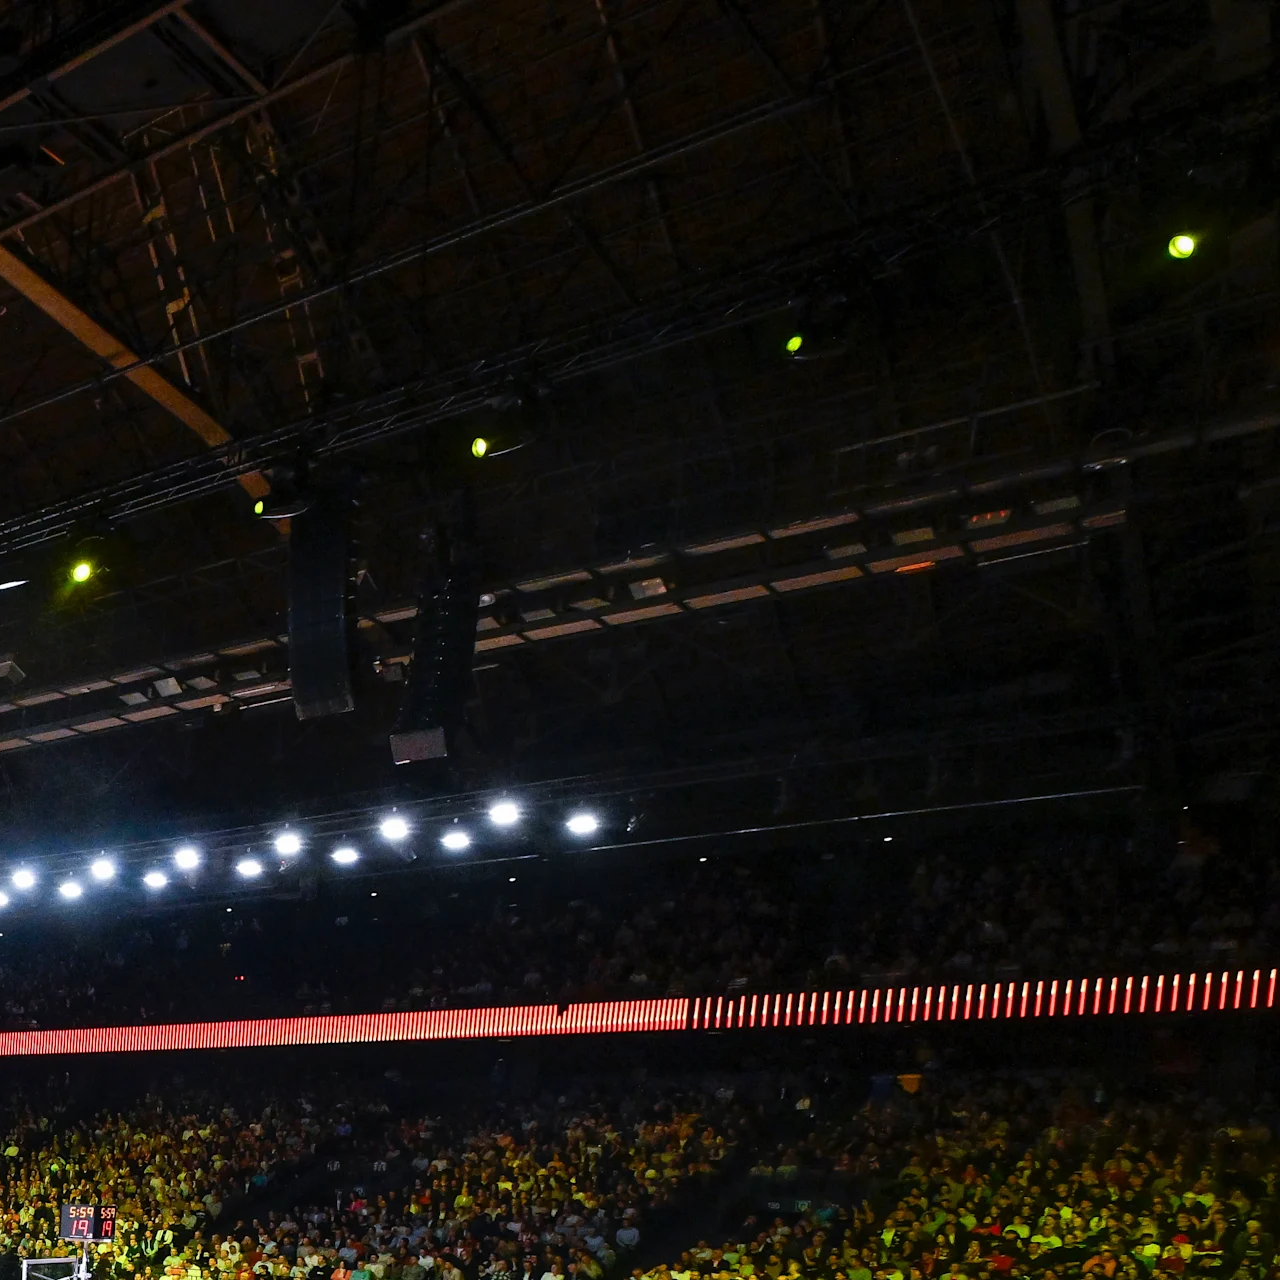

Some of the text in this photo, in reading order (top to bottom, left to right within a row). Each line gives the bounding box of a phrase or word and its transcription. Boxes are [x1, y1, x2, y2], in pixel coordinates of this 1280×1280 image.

[69, 1206, 95, 1219] 5:59
[100, 1207, 116, 1219] 5:59
[72, 1220, 89, 1236] 19
[101, 1220, 113, 1237] 19
